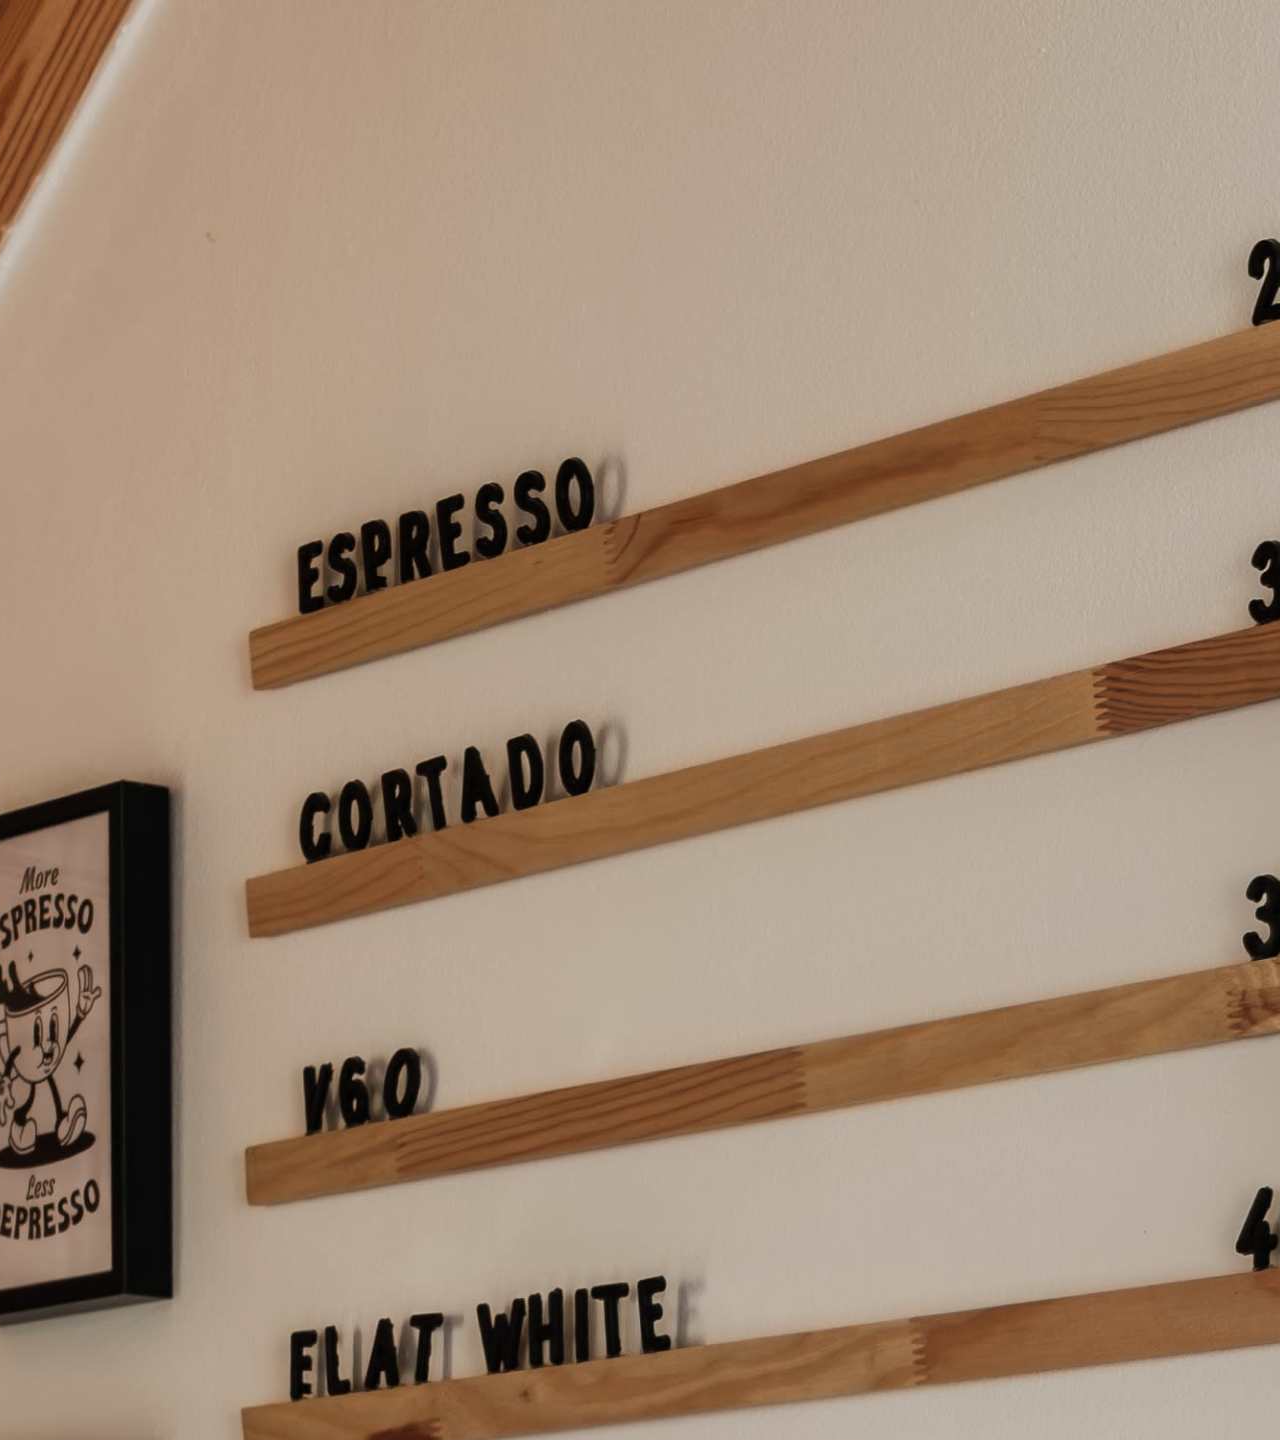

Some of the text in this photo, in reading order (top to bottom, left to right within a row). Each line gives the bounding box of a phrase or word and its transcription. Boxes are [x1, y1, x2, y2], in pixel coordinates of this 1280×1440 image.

[297, 457, 595, 615] ESPRESSO
[299, 719, 597, 864] CORTADO
[19, 866, 60, 895] More
[26, 1174, 56, 1201] Less
[477, 1276, 671, 1374] WHITE
[1235, 1186, 1279, 1271] 4
